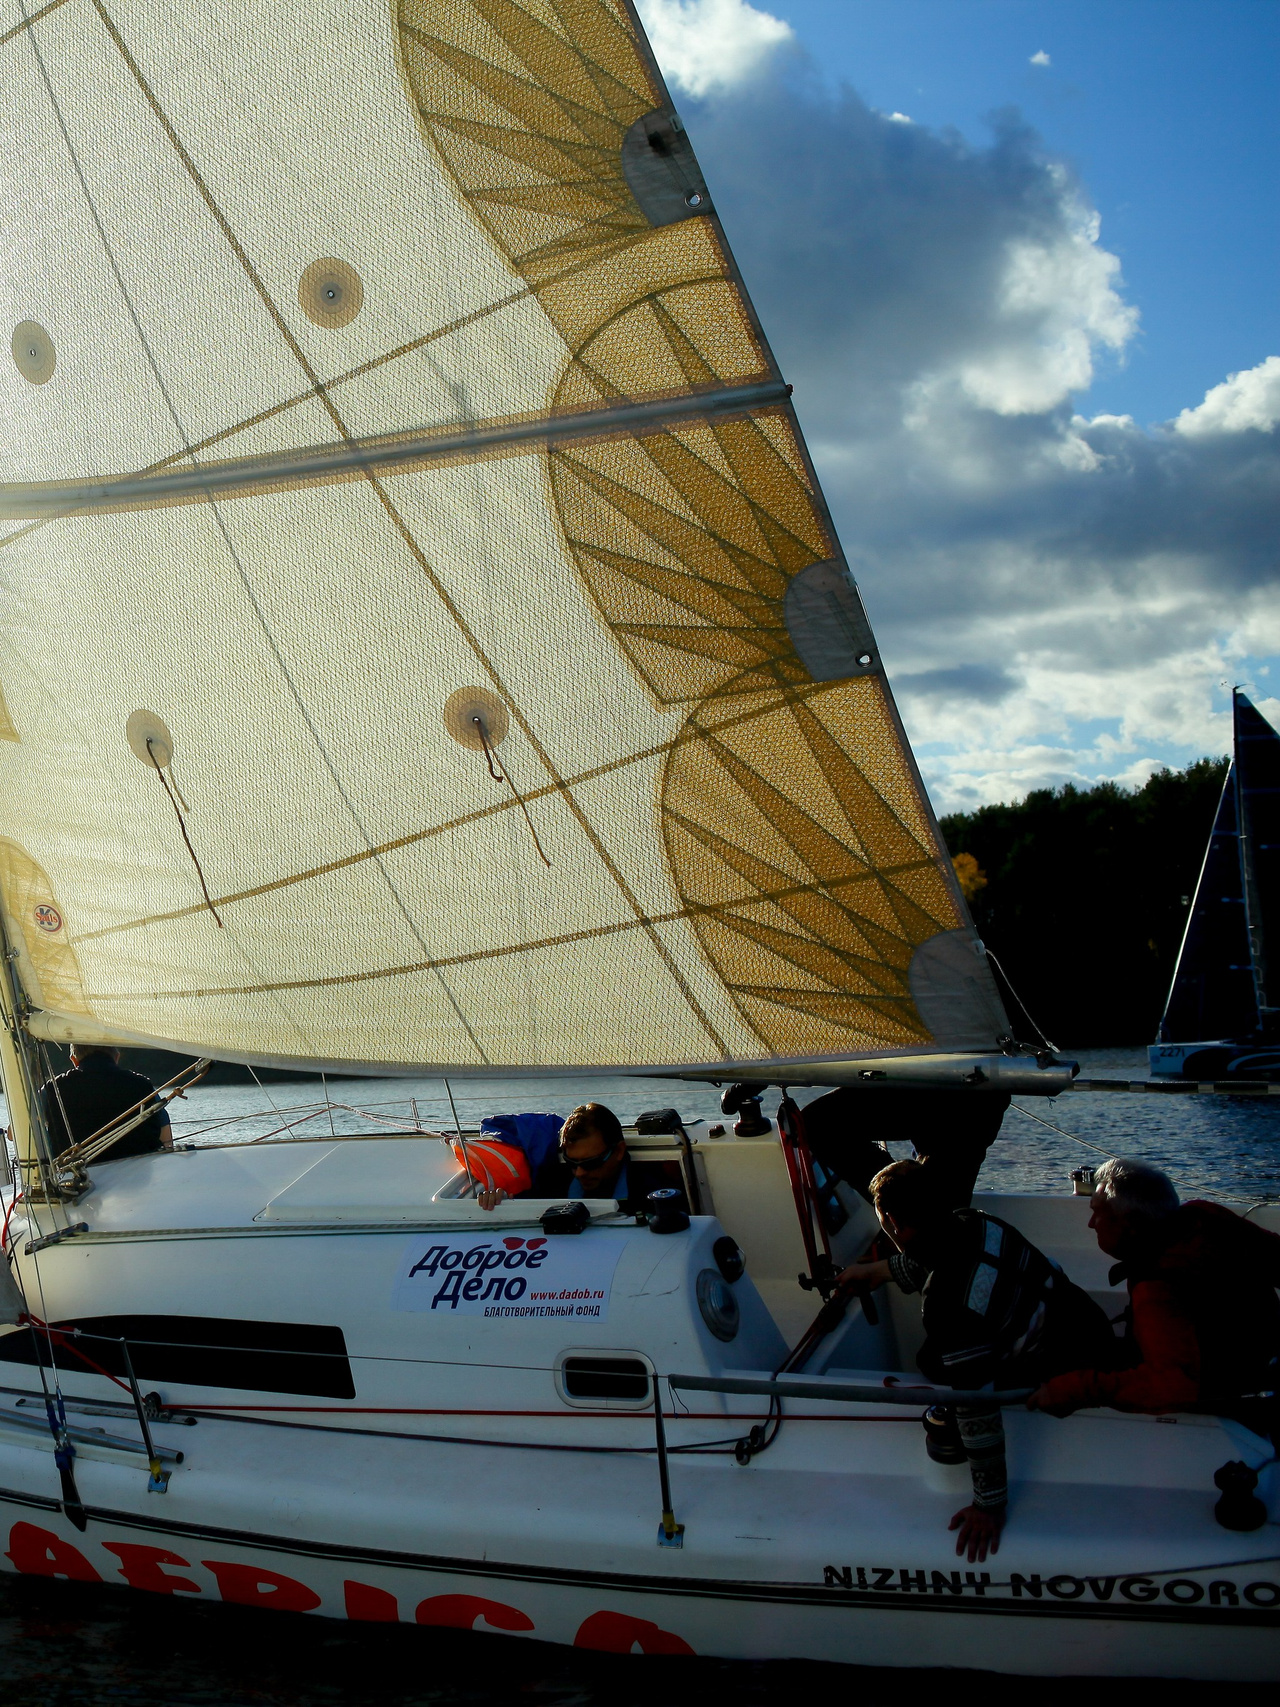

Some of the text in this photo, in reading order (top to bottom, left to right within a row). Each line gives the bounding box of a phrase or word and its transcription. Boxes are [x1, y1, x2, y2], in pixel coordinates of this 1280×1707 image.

[408, 1244, 549, 1278] Доброе
[430, 1270, 527, 1309] Дело
[530, 1288, 604, 1301] www.dadob.ru
[483, 1304, 601, 1318] БЛАГОТВОРИТЕЛЬНЫЙ ФОНД
[823, 1565, 991, 1596] NIZHNY
